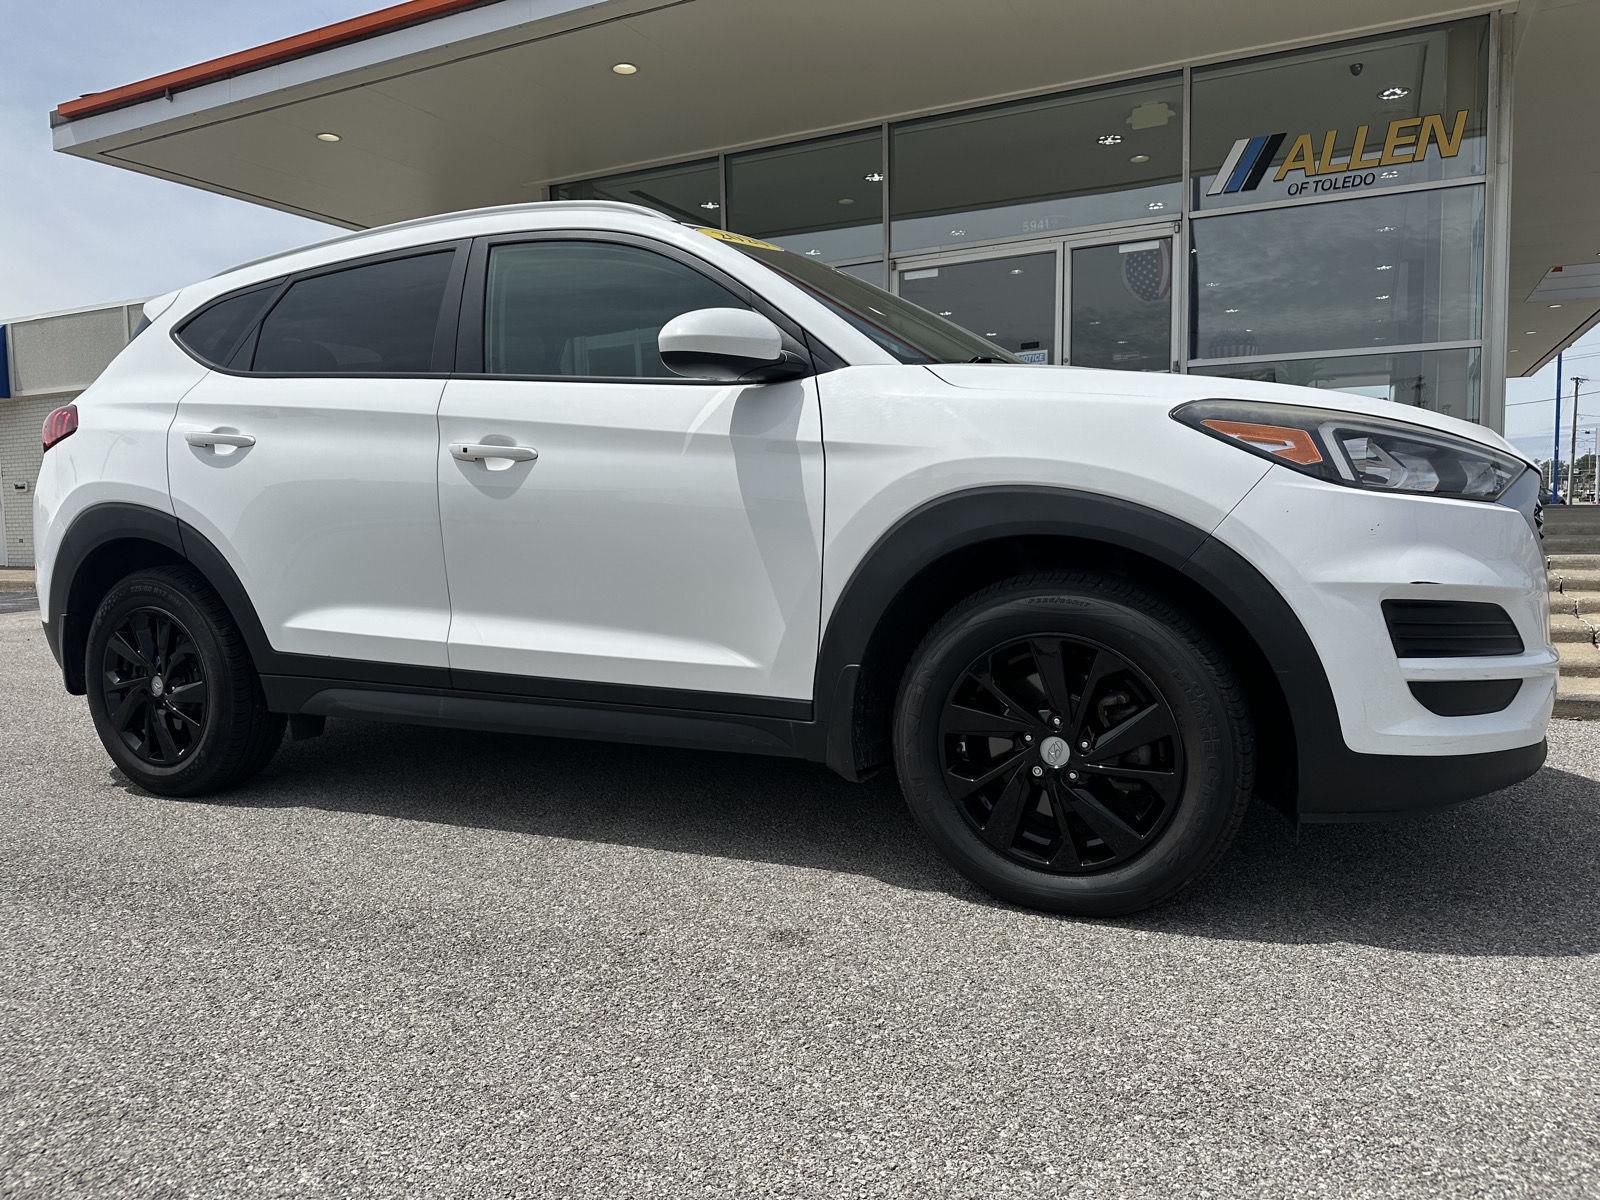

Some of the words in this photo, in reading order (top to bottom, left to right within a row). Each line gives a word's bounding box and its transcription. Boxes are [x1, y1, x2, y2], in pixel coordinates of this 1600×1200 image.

[1273, 110, 1469, 182] ALLEN
[1287, 181, 1313, 196] OF
[1315, 172, 1376, 193] TOLEDO
